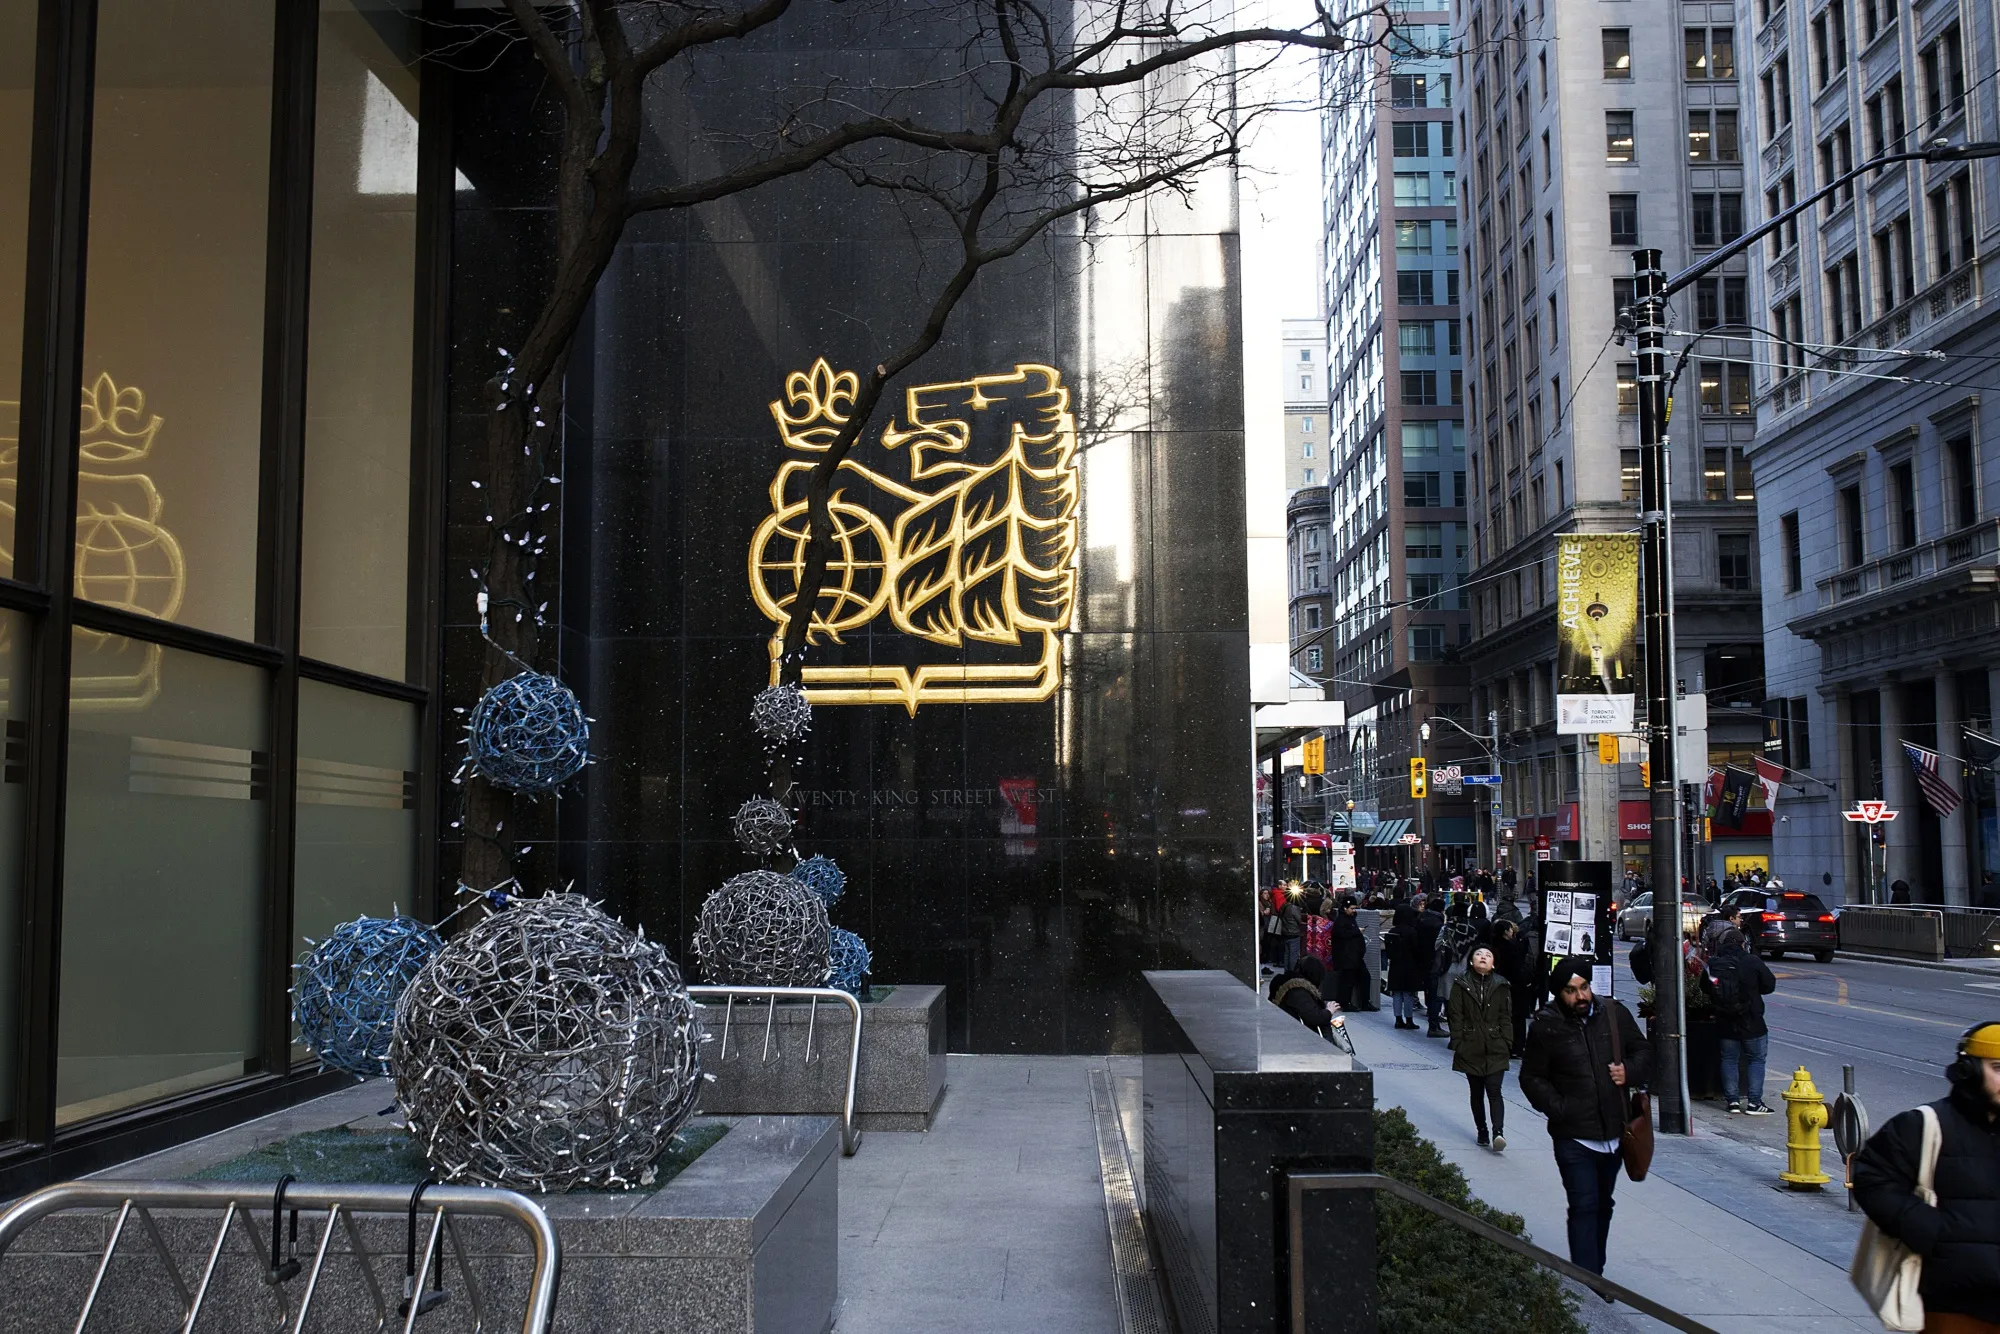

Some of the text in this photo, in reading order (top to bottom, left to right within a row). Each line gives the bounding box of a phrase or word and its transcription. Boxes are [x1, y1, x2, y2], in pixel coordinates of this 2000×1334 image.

[1562, 543, 1581, 630] ACHIEVE
[1473, 776, 1489, 785] Yonge
[873, 789, 919, 805] KING
[931, 789, 996, 804] STREET
[1009, 788, 1057, 804] WEST
